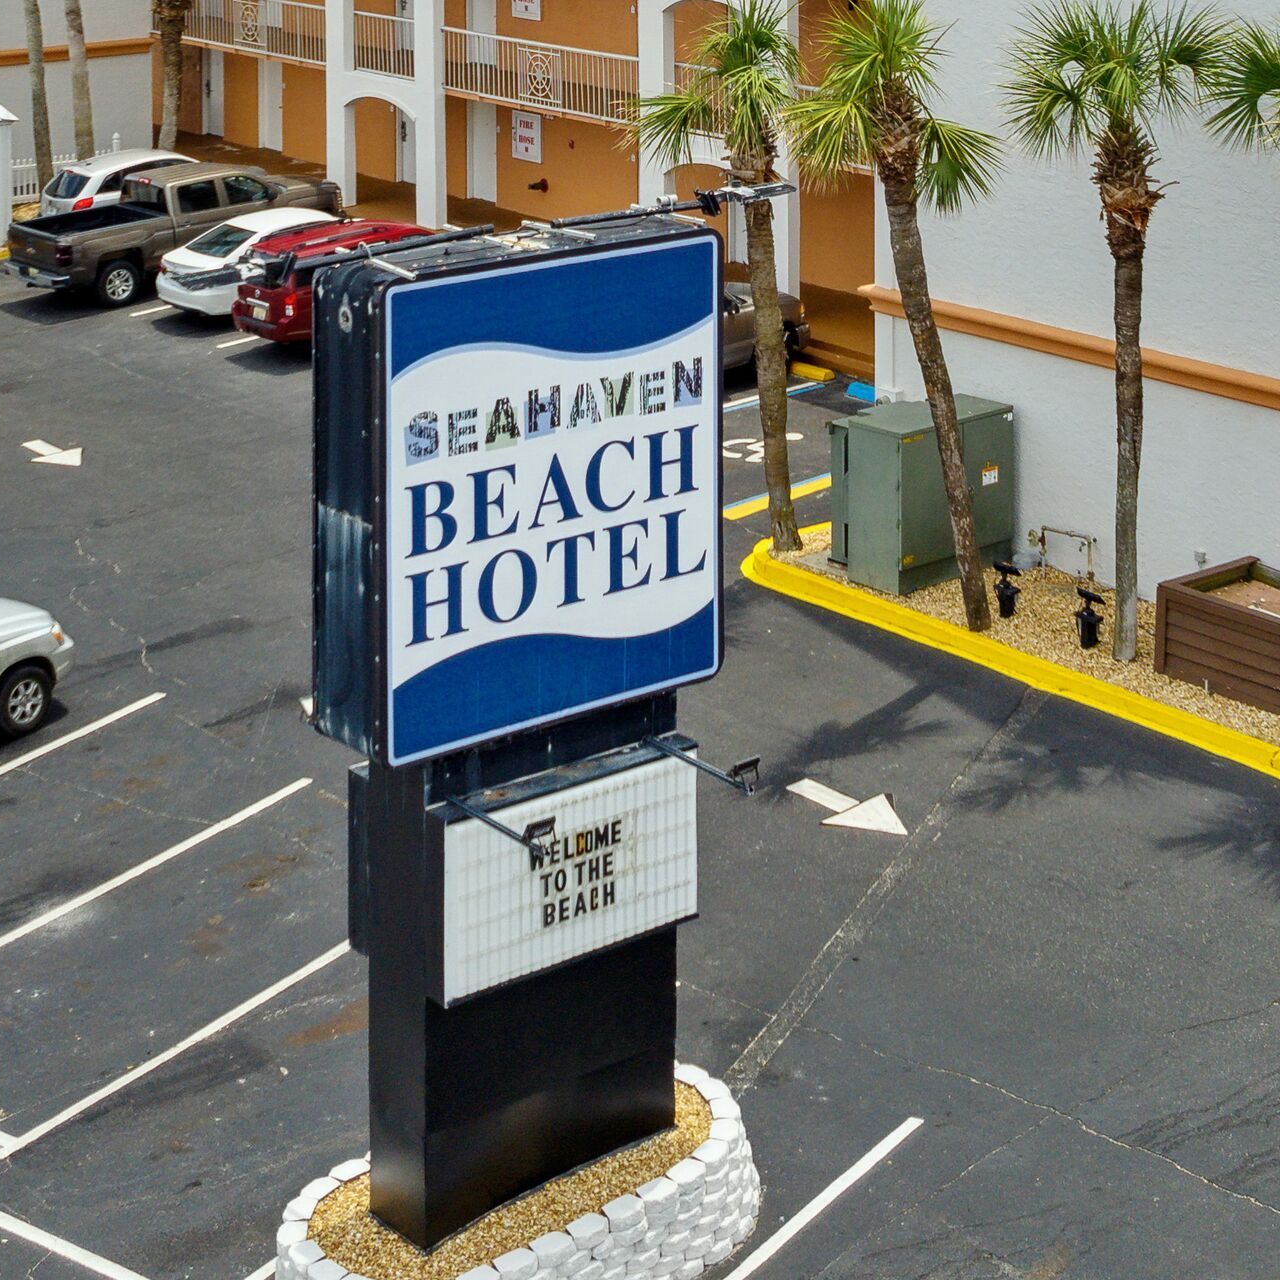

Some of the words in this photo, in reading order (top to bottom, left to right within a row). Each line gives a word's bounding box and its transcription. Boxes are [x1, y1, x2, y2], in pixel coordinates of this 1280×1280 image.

[518, 134, 536, 146] HOSE
[519, 119, 535, 130] FIRE
[406, 356, 703, 459] SEAHAVEN
[405, 424, 700, 560] BEACH
[405, 509, 707, 648] HOTEL
[540, 869, 567, 897] TO
[575, 852, 614, 886] THE
[543, 880, 616, 928] BEACH
